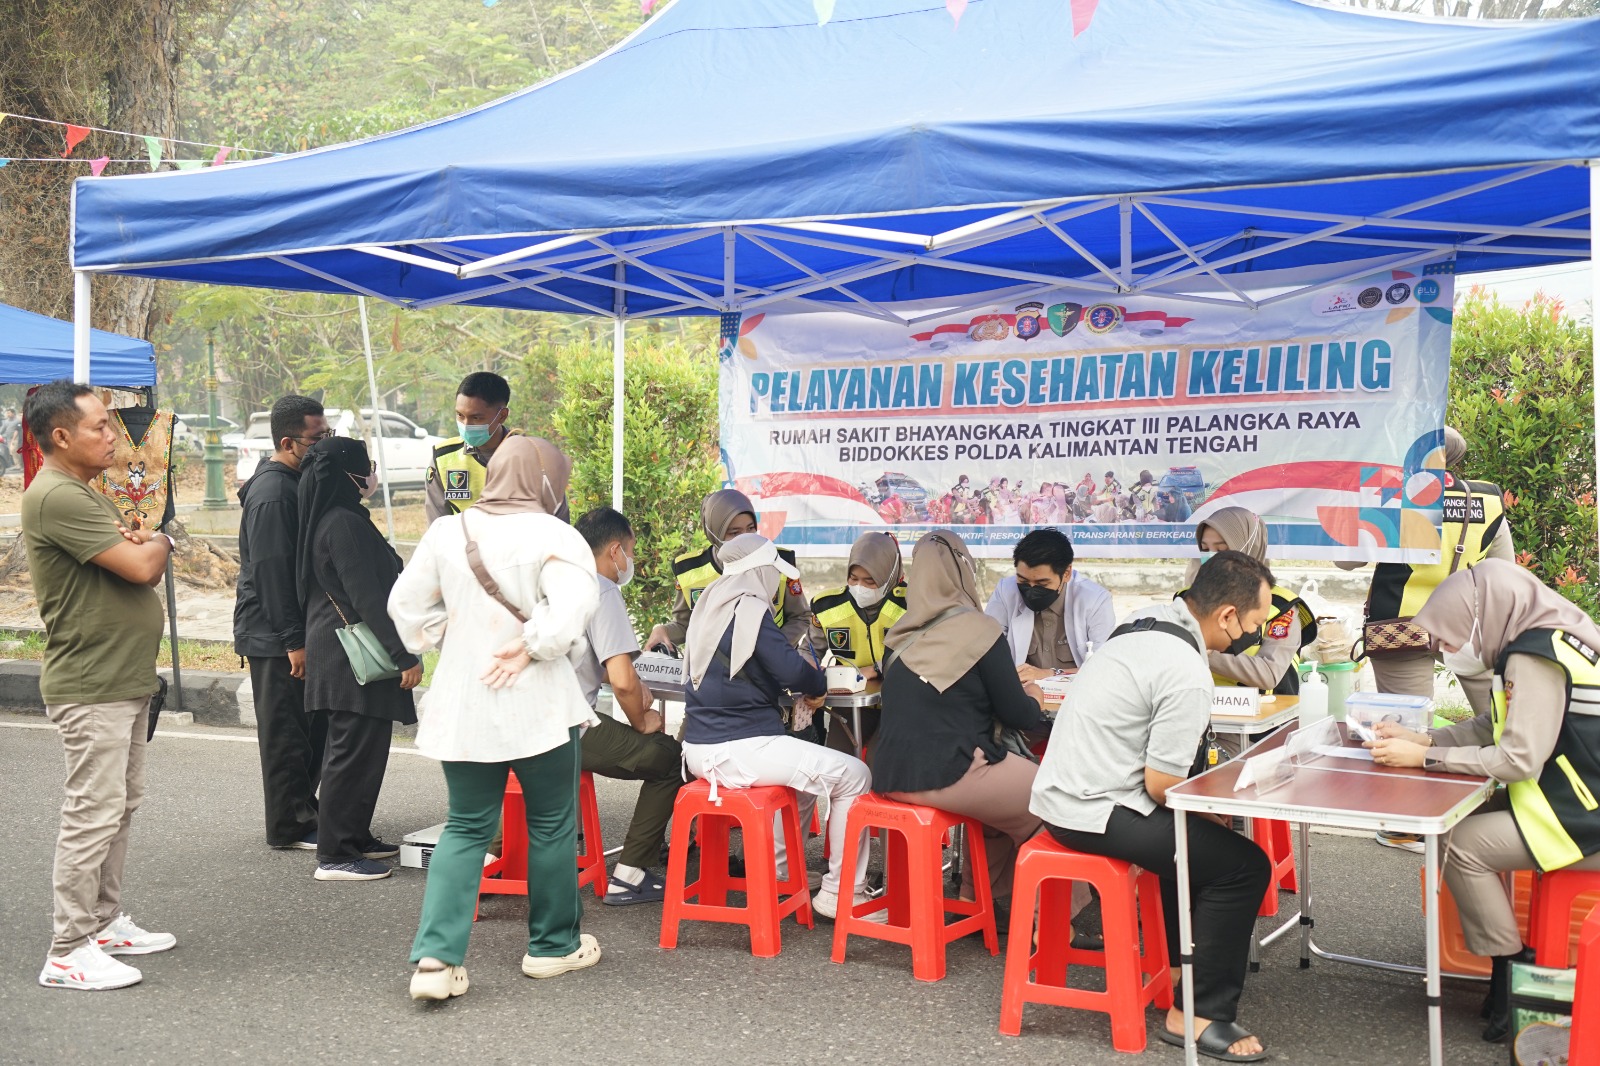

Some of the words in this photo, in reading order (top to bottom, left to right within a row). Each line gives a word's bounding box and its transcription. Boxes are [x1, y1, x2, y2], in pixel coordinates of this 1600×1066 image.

[750, 363, 943, 413] PELAYANAN
[953, 350, 1178, 406] KESEHATAN
[1188, 340, 1391, 395] KELILING
[769, 428, 830, 446] RUMAH
[836, 426, 890, 443] SAKIT
[895, 423, 1043, 442] BHAYANGKARA
[1049, 418, 1136, 439] TINGKAT
[1142, 417, 1160, 434] III
[1166, 413, 1288, 433] PALANGKA
[1298, 411, 1361, 429] RAYA
[839, 445, 949, 462] BIDDOKKES
[954, 444, 1022, 460] POLDA
[1029, 437, 1158, 458] KALIMANTAN
[1166, 435, 1258, 454] TENGAH
[1443, 499, 1482, 508] YANGKRA
[1446, 509, 1483, 519] KALTNG
[1073, 531, 1143, 539] TRANSPARANSI
[1212, 696, 1250, 706] HANA
